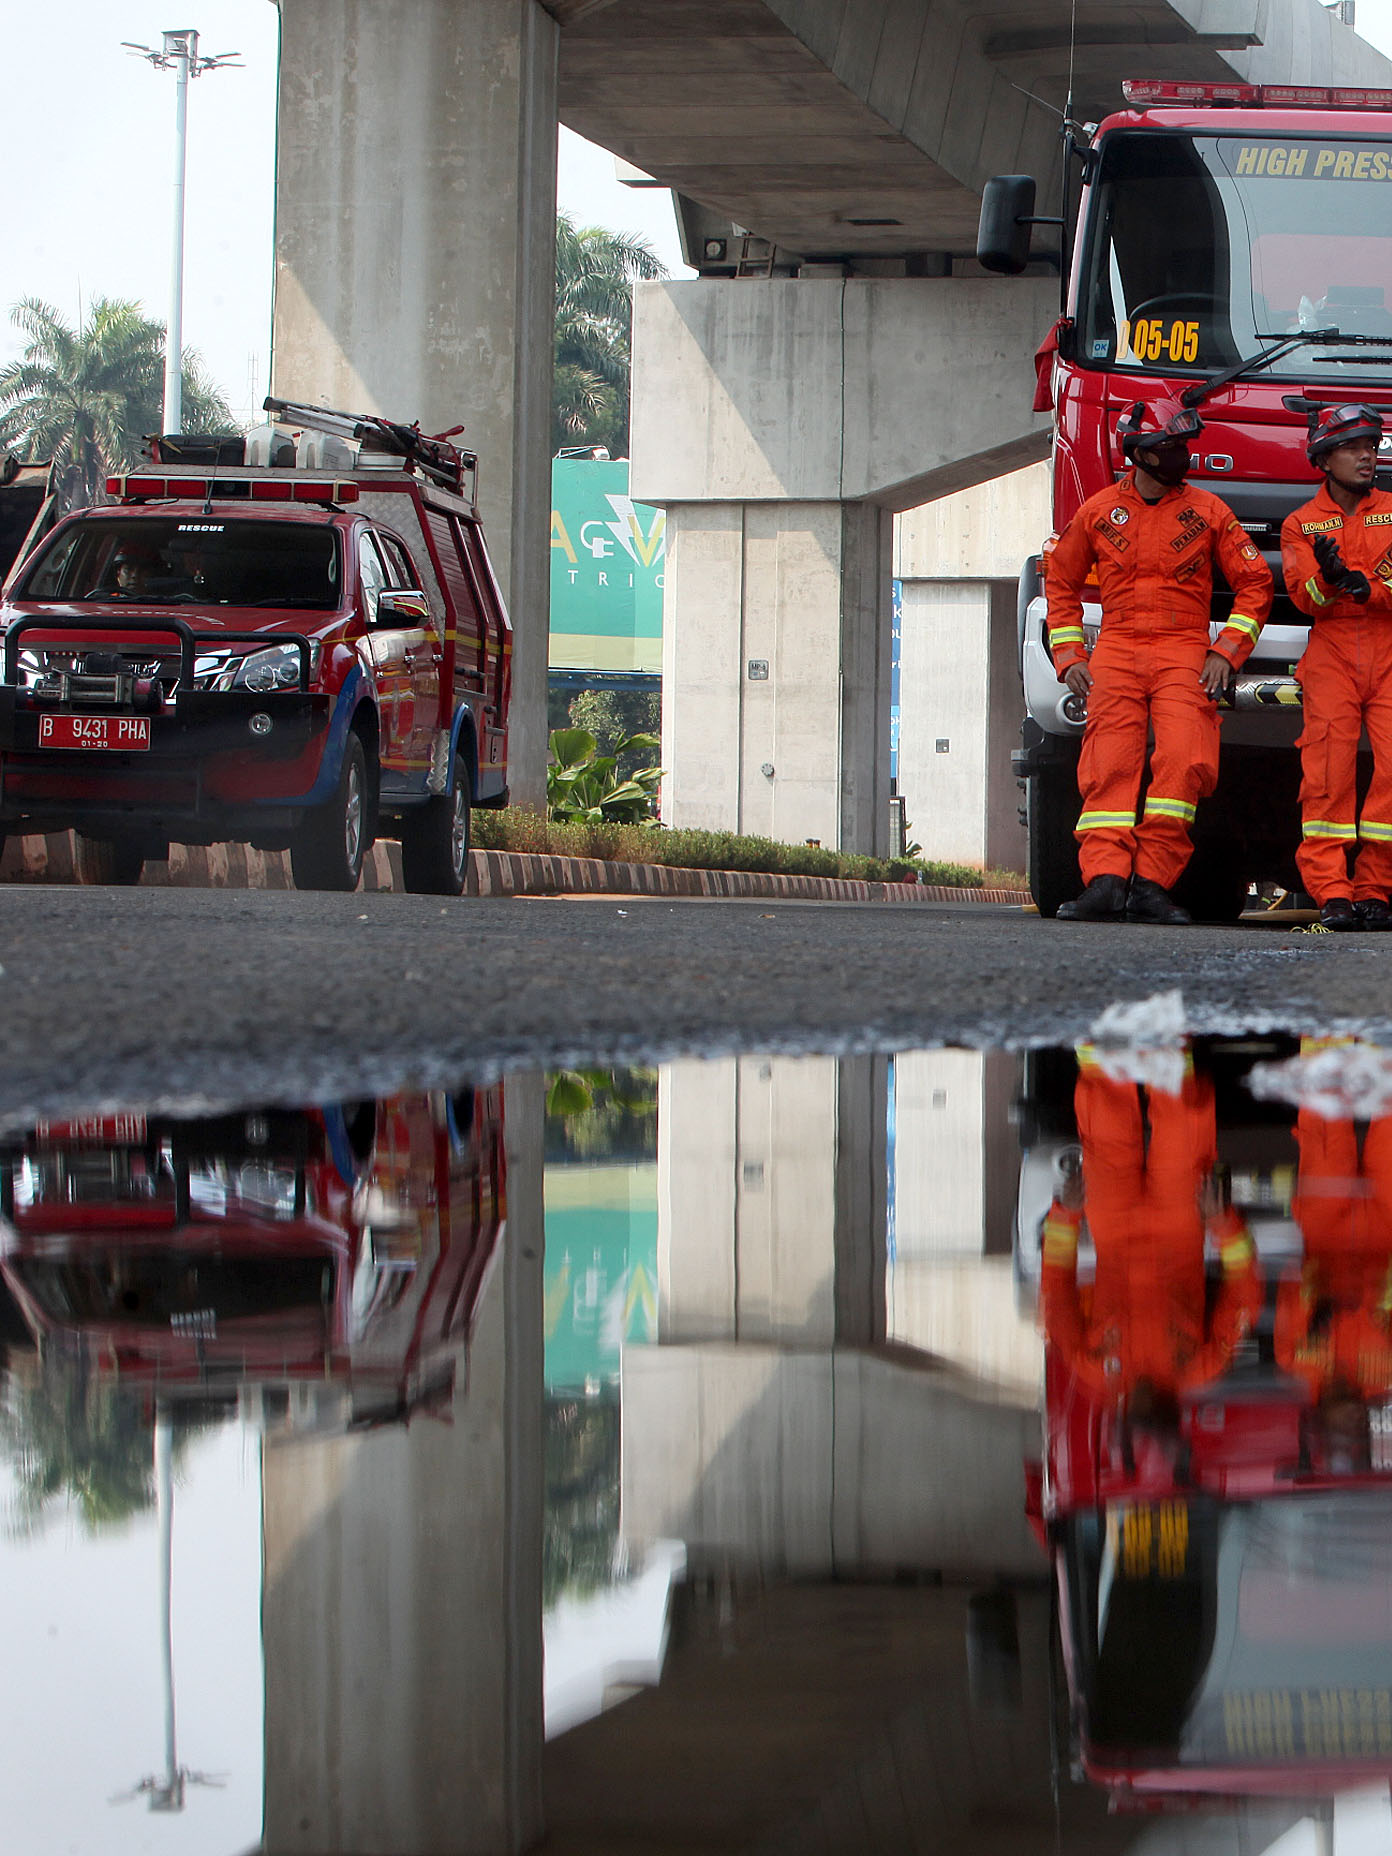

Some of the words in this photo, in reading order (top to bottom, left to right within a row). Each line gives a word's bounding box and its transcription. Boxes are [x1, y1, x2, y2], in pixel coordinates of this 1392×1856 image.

[1236, 147, 1308, 176] HIGH
[1094, 343, 1107, 352] OK
[1133, 319, 1200, 362] 05-05
[178, 524, 225, 532] RESCUE
[43, 717, 54, 737] B
[72, 719, 108, 739] 9431
[118, 720, 147, 739] PHA
[81, 740, 108, 748] 01-20
